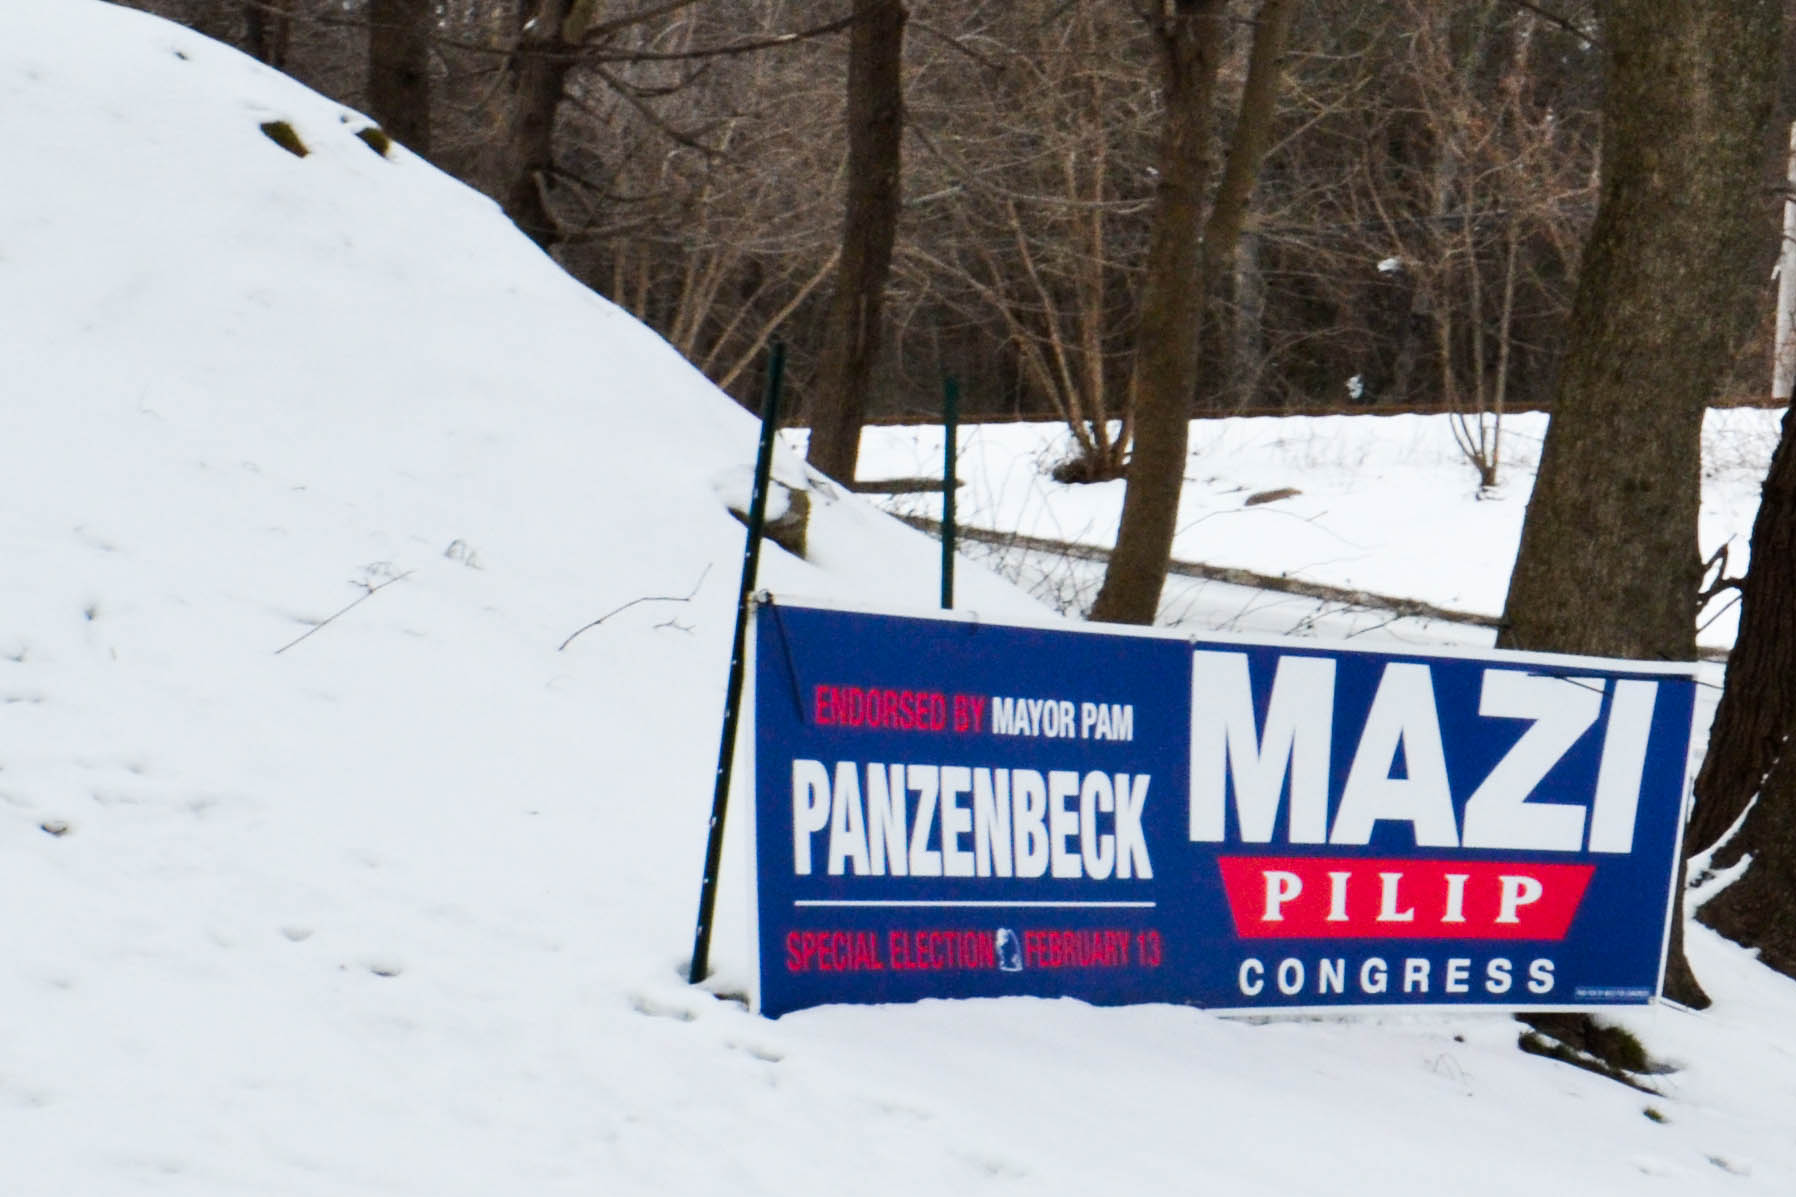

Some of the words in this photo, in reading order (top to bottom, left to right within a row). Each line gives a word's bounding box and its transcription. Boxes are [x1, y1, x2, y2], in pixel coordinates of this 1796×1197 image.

[814, 685, 946, 731] ENDORSED
[954, 695, 985, 733] BY
[992, 697, 1075, 738] MAYOR
[1081, 703, 1133, 741] PAM
[1189, 650, 1659, 853] MAZI
[793, 759, 1153, 879] PANZENBECK
[1261, 870, 1543, 924] PILIP
[787, 931, 884, 971] SPECIAL
[889, 931, 995, 970] ELECTION
[1024, 930, 1131, 968] FEBRUARY
[1136, 930, 1162, 967] 13
[1239, 958, 1555, 996] CONGRESS
